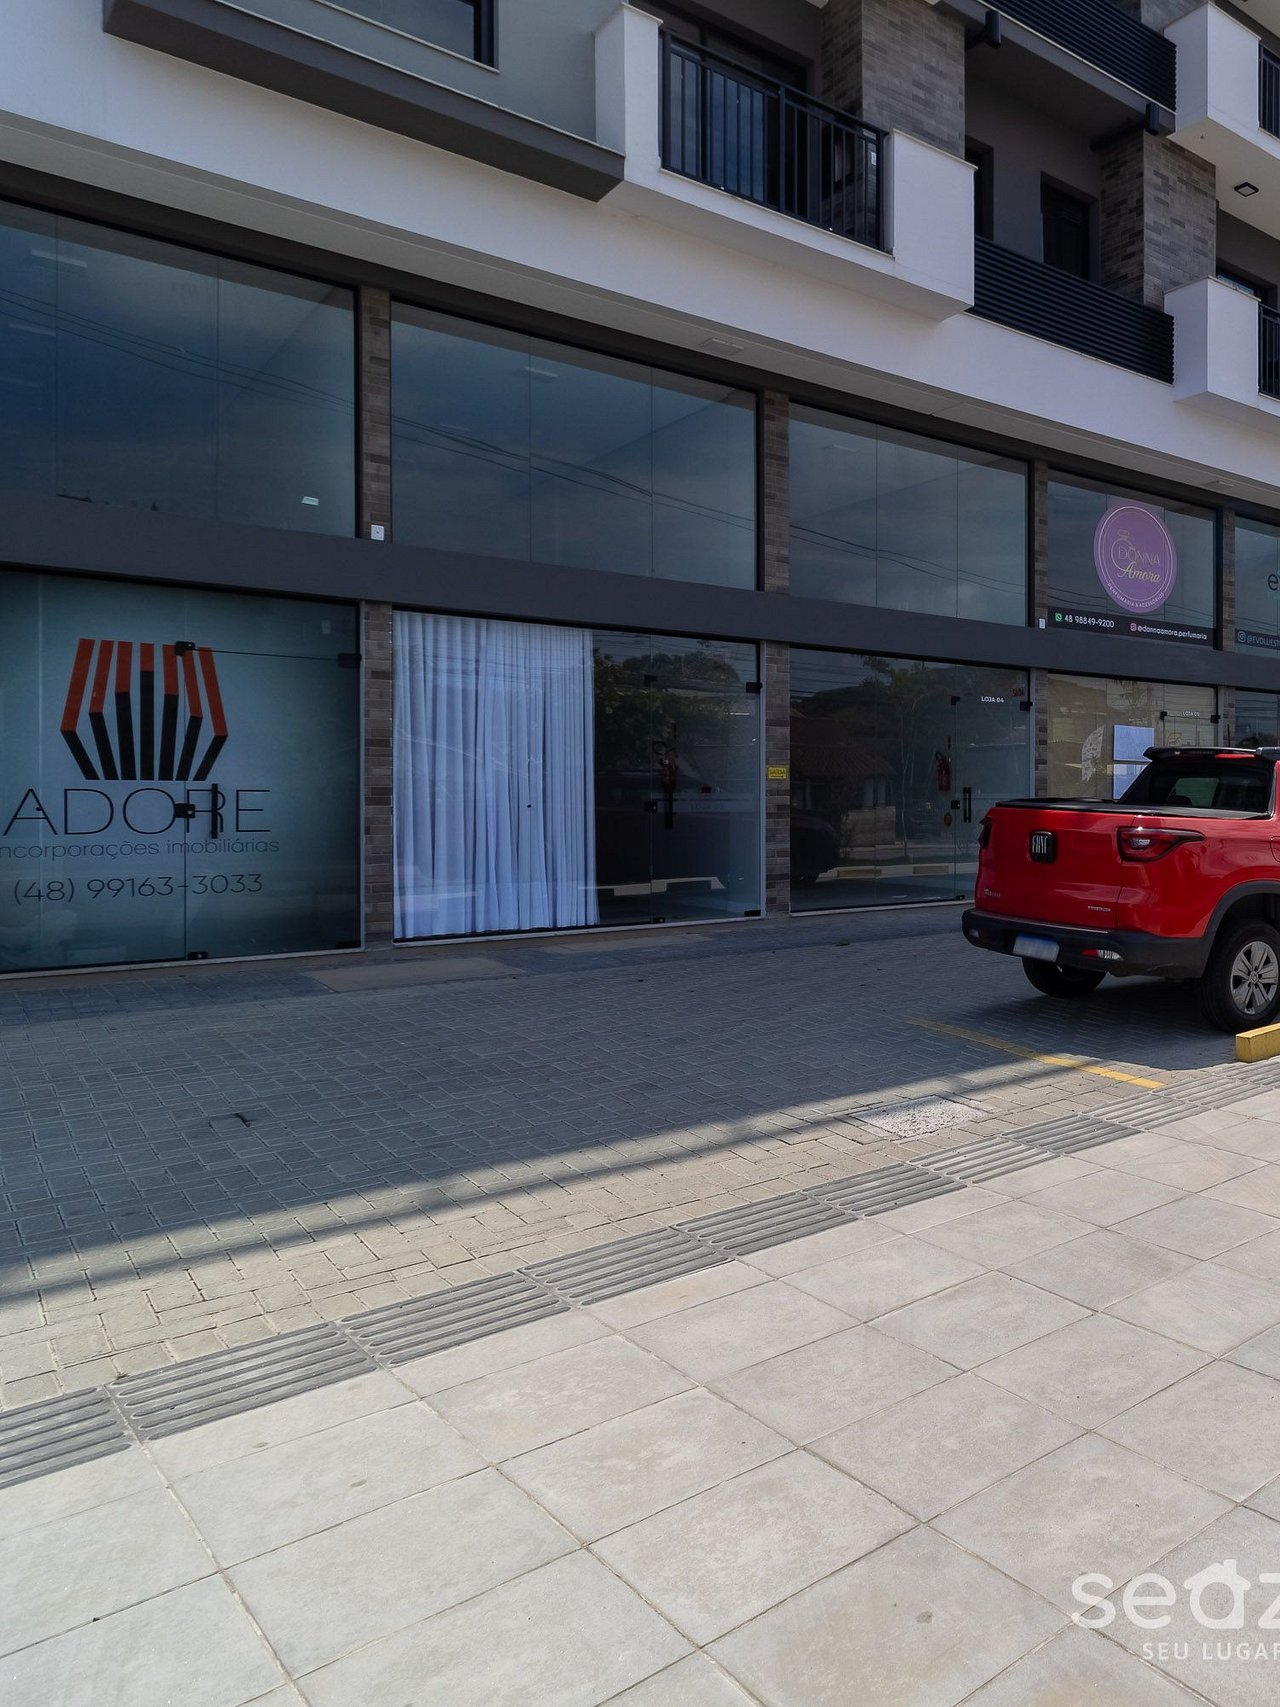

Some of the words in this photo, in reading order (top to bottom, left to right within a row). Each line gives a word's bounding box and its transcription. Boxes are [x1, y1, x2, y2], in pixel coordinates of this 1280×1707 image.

[1117, 561, 1161, 583] Amora
[1064, 614, 1073, 623] 48
[3, 787, 271, 836] ADORE
[0, 839, 160, 860] ncorporações
[167, 838, 280, 855] imobiliárias
[1031, 835, 1049, 854] FIAT
[14, 877, 75, 905] (48)
[86, 873, 263, 899] 99163-3033
